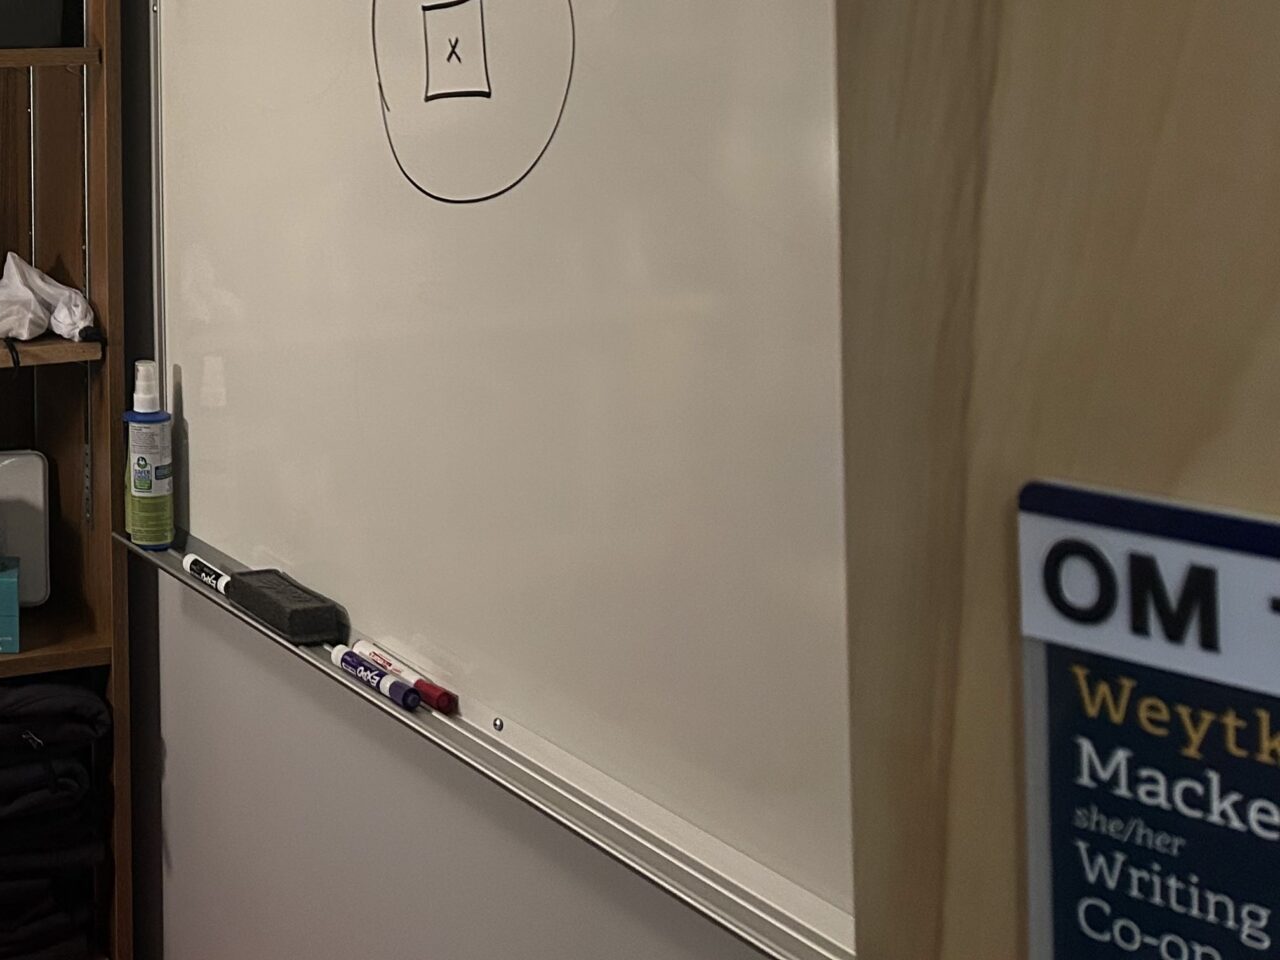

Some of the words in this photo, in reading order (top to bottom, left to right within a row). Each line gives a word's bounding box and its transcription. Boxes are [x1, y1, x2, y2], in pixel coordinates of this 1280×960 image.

[1042, 537, 1222, 655] OM
[356, 665, 380, 688] EXPO
[1073, 803, 1187, 858] she/her
[1075, 837, 1272, 951] Writing
